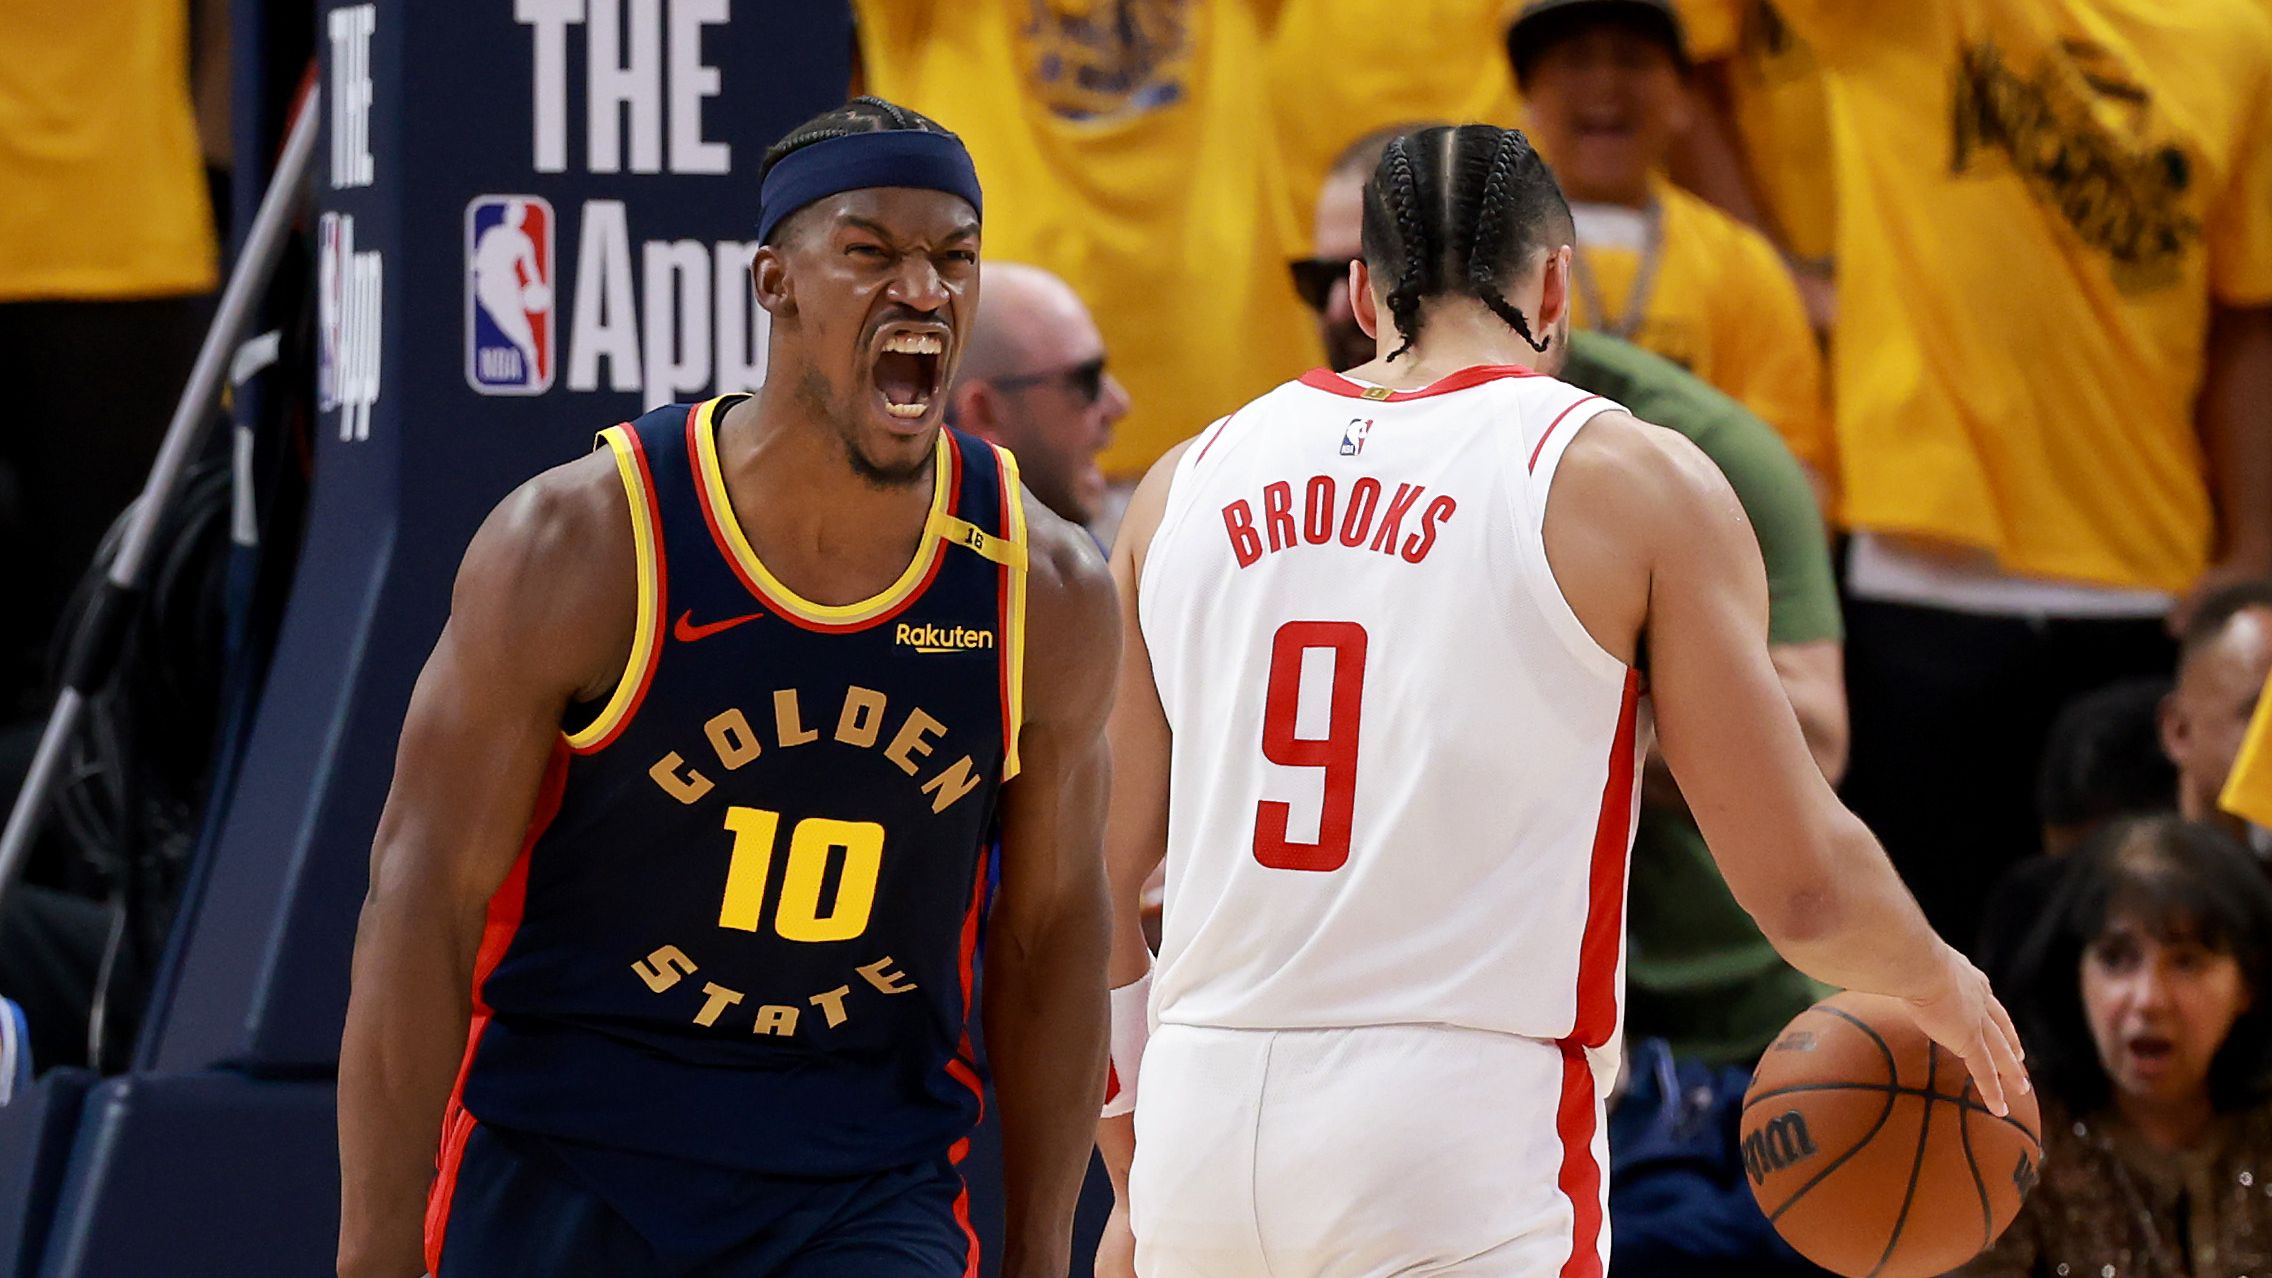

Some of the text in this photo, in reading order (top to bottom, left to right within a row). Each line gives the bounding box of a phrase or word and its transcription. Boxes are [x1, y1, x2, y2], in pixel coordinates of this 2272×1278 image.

[513, 0, 732, 174] THE
[567, 199, 772, 414] App
[1221, 475, 1457, 569] BROOKS
[895, 622, 993, 649] Rakuten
[648, 685, 981, 815] GOLDEN
[1252, 620, 1368, 872] 9
[718, 805, 885, 942] 10
[630, 944, 918, 1037] STATE
